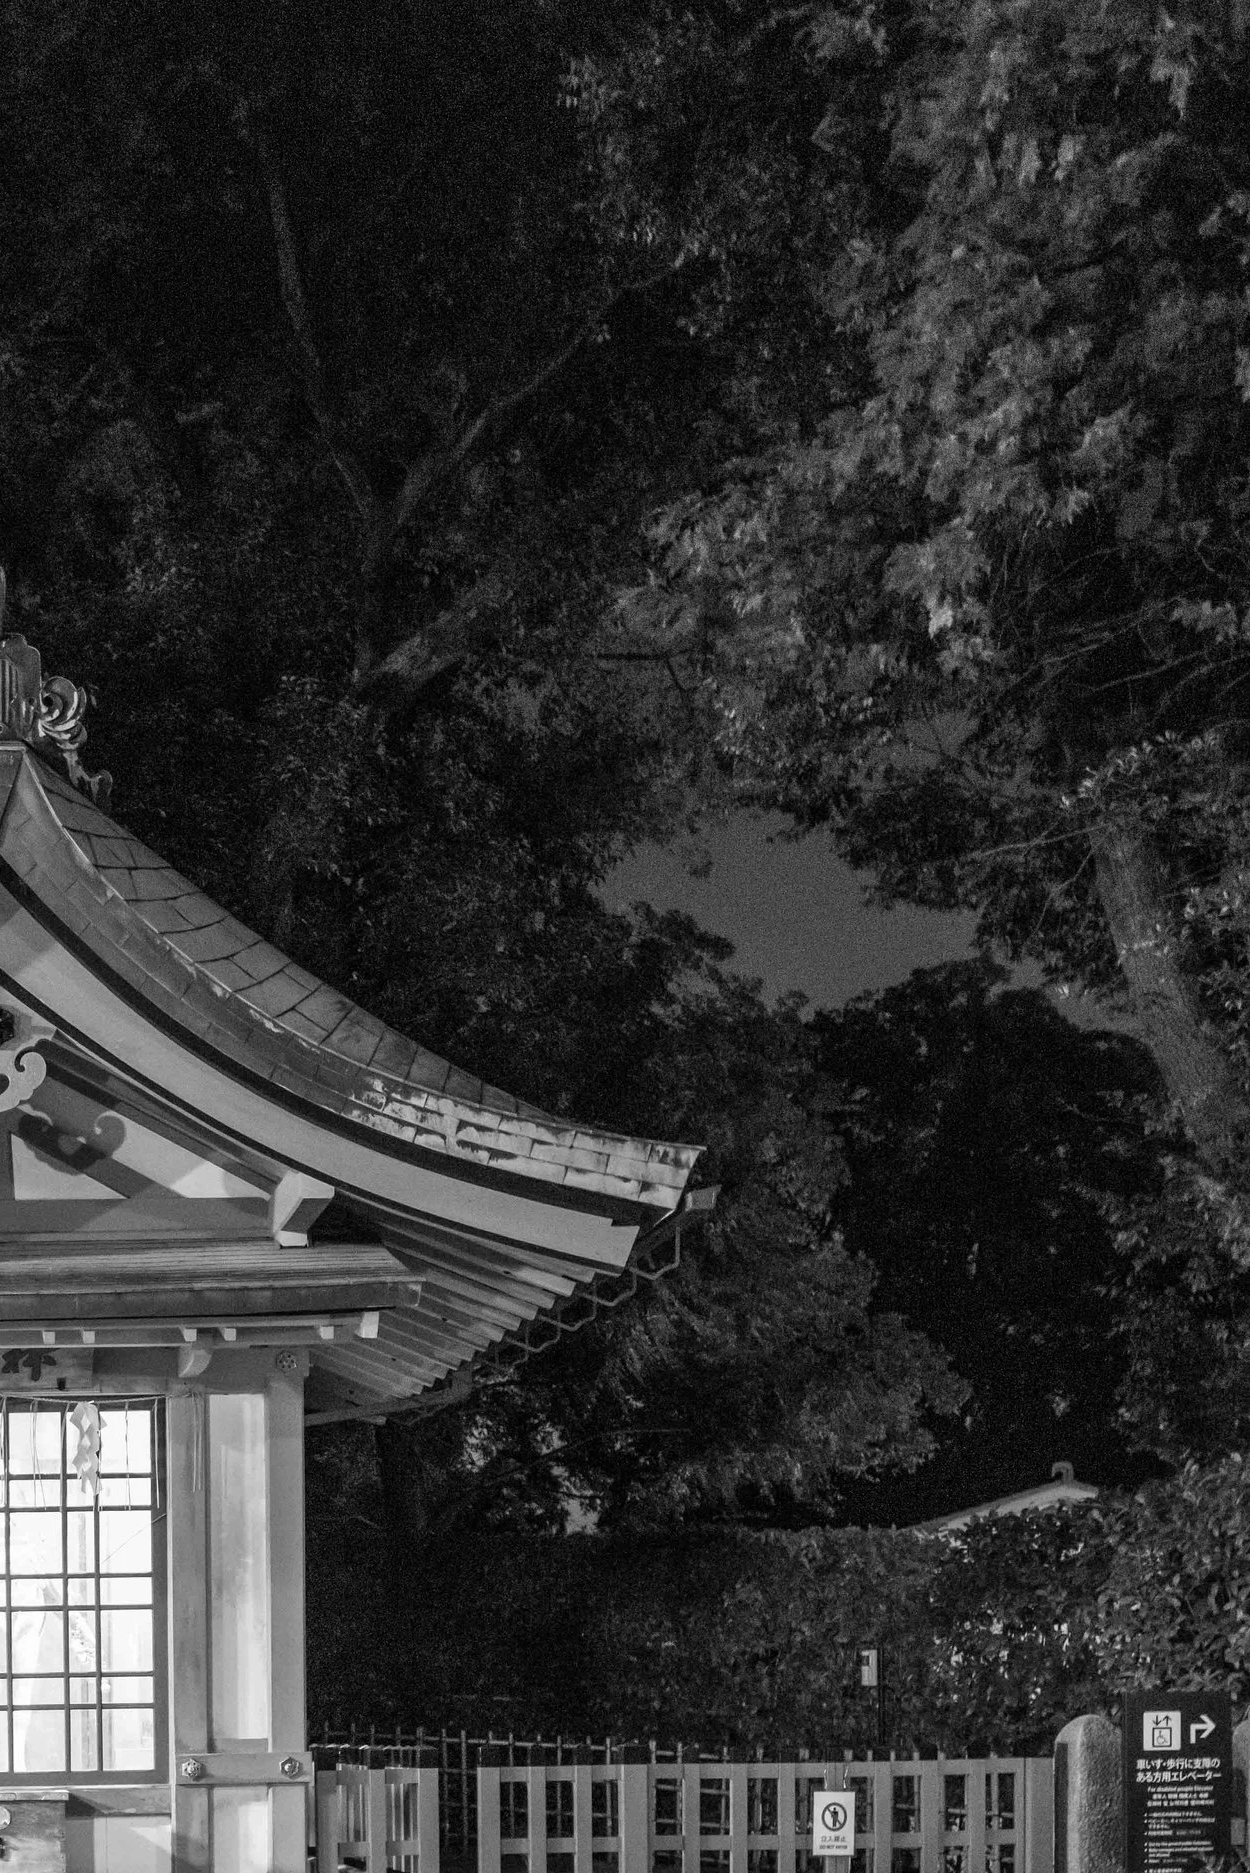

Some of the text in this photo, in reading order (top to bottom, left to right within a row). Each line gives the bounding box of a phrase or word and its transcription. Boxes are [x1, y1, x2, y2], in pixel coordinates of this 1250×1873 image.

[1135, 1770, 1222, 1783] ある方用エレベーター
